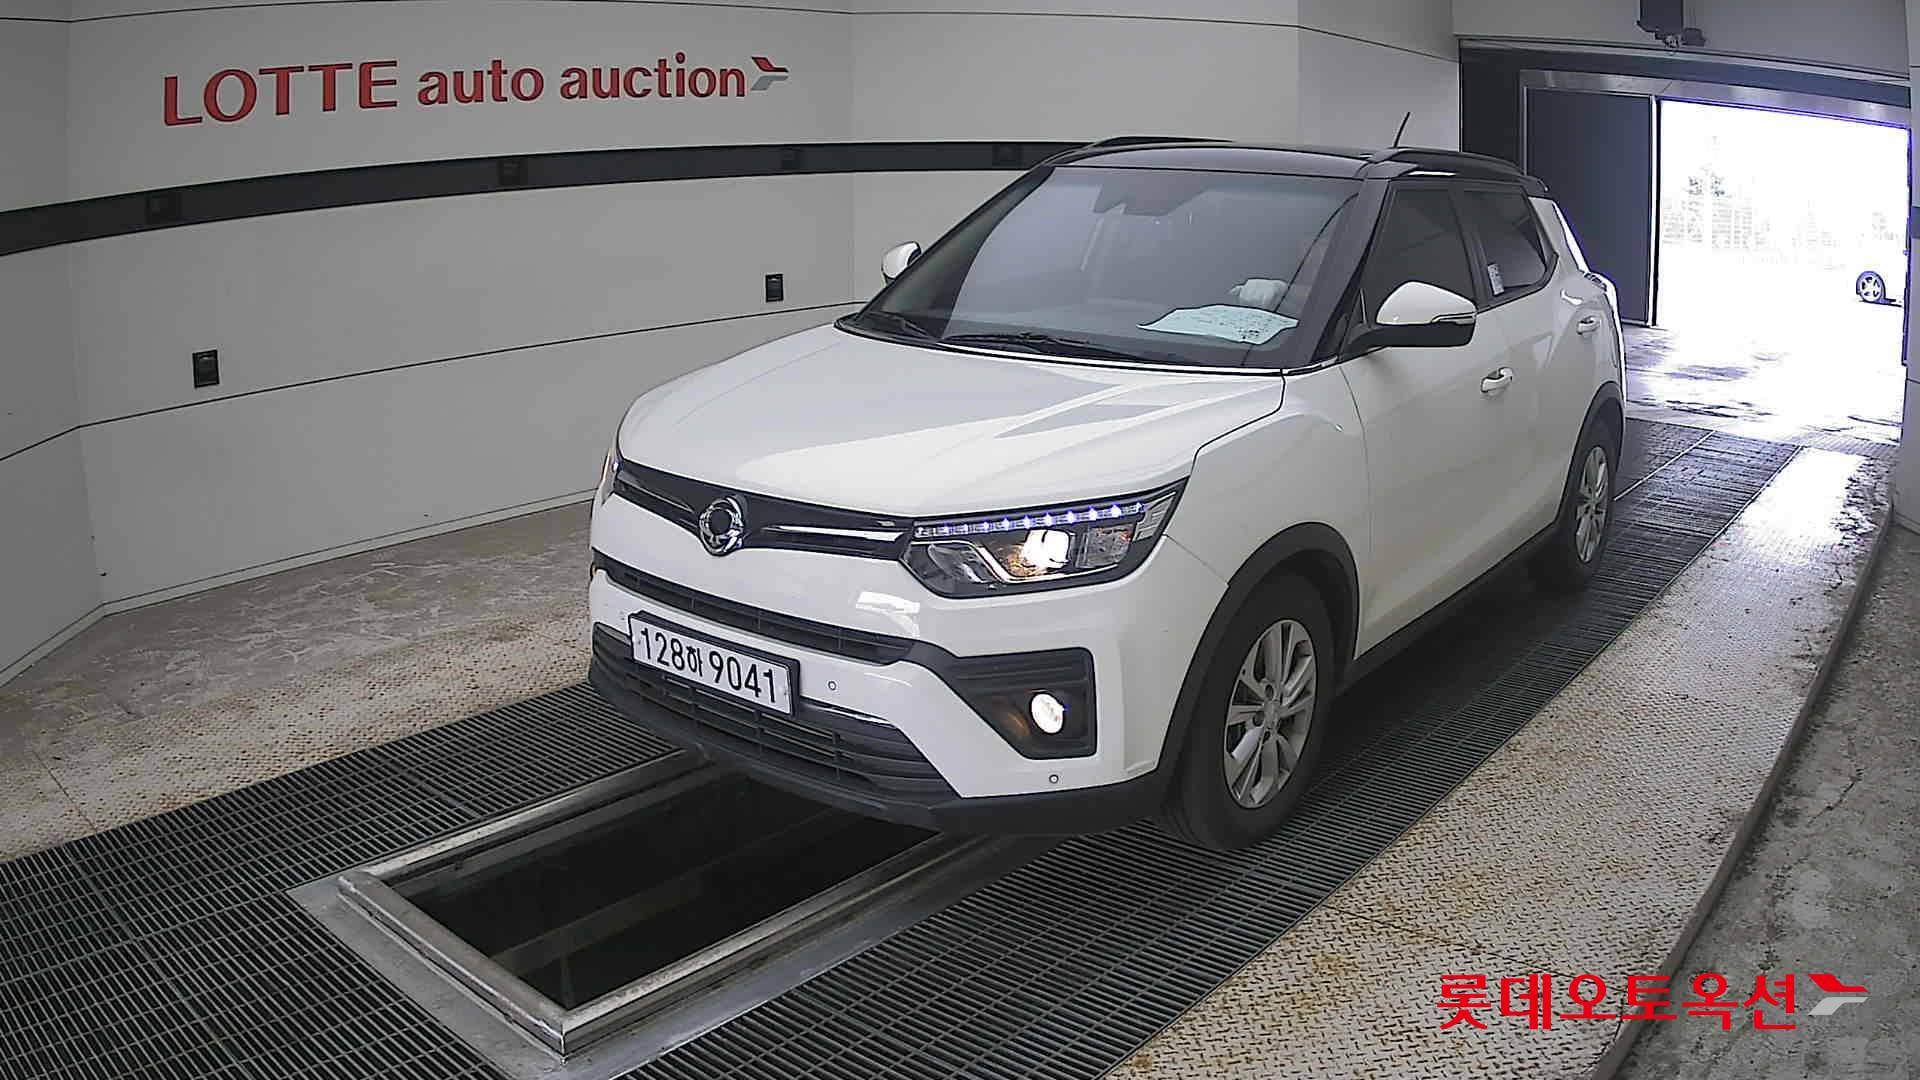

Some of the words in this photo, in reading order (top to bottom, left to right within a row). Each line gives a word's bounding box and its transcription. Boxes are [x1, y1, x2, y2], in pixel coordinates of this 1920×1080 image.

[163, 59, 399, 126] LOTTE
[417, 59, 544, 105] auto
[560, 52, 746, 99] auction
[708, 651, 776, 703] 9041
